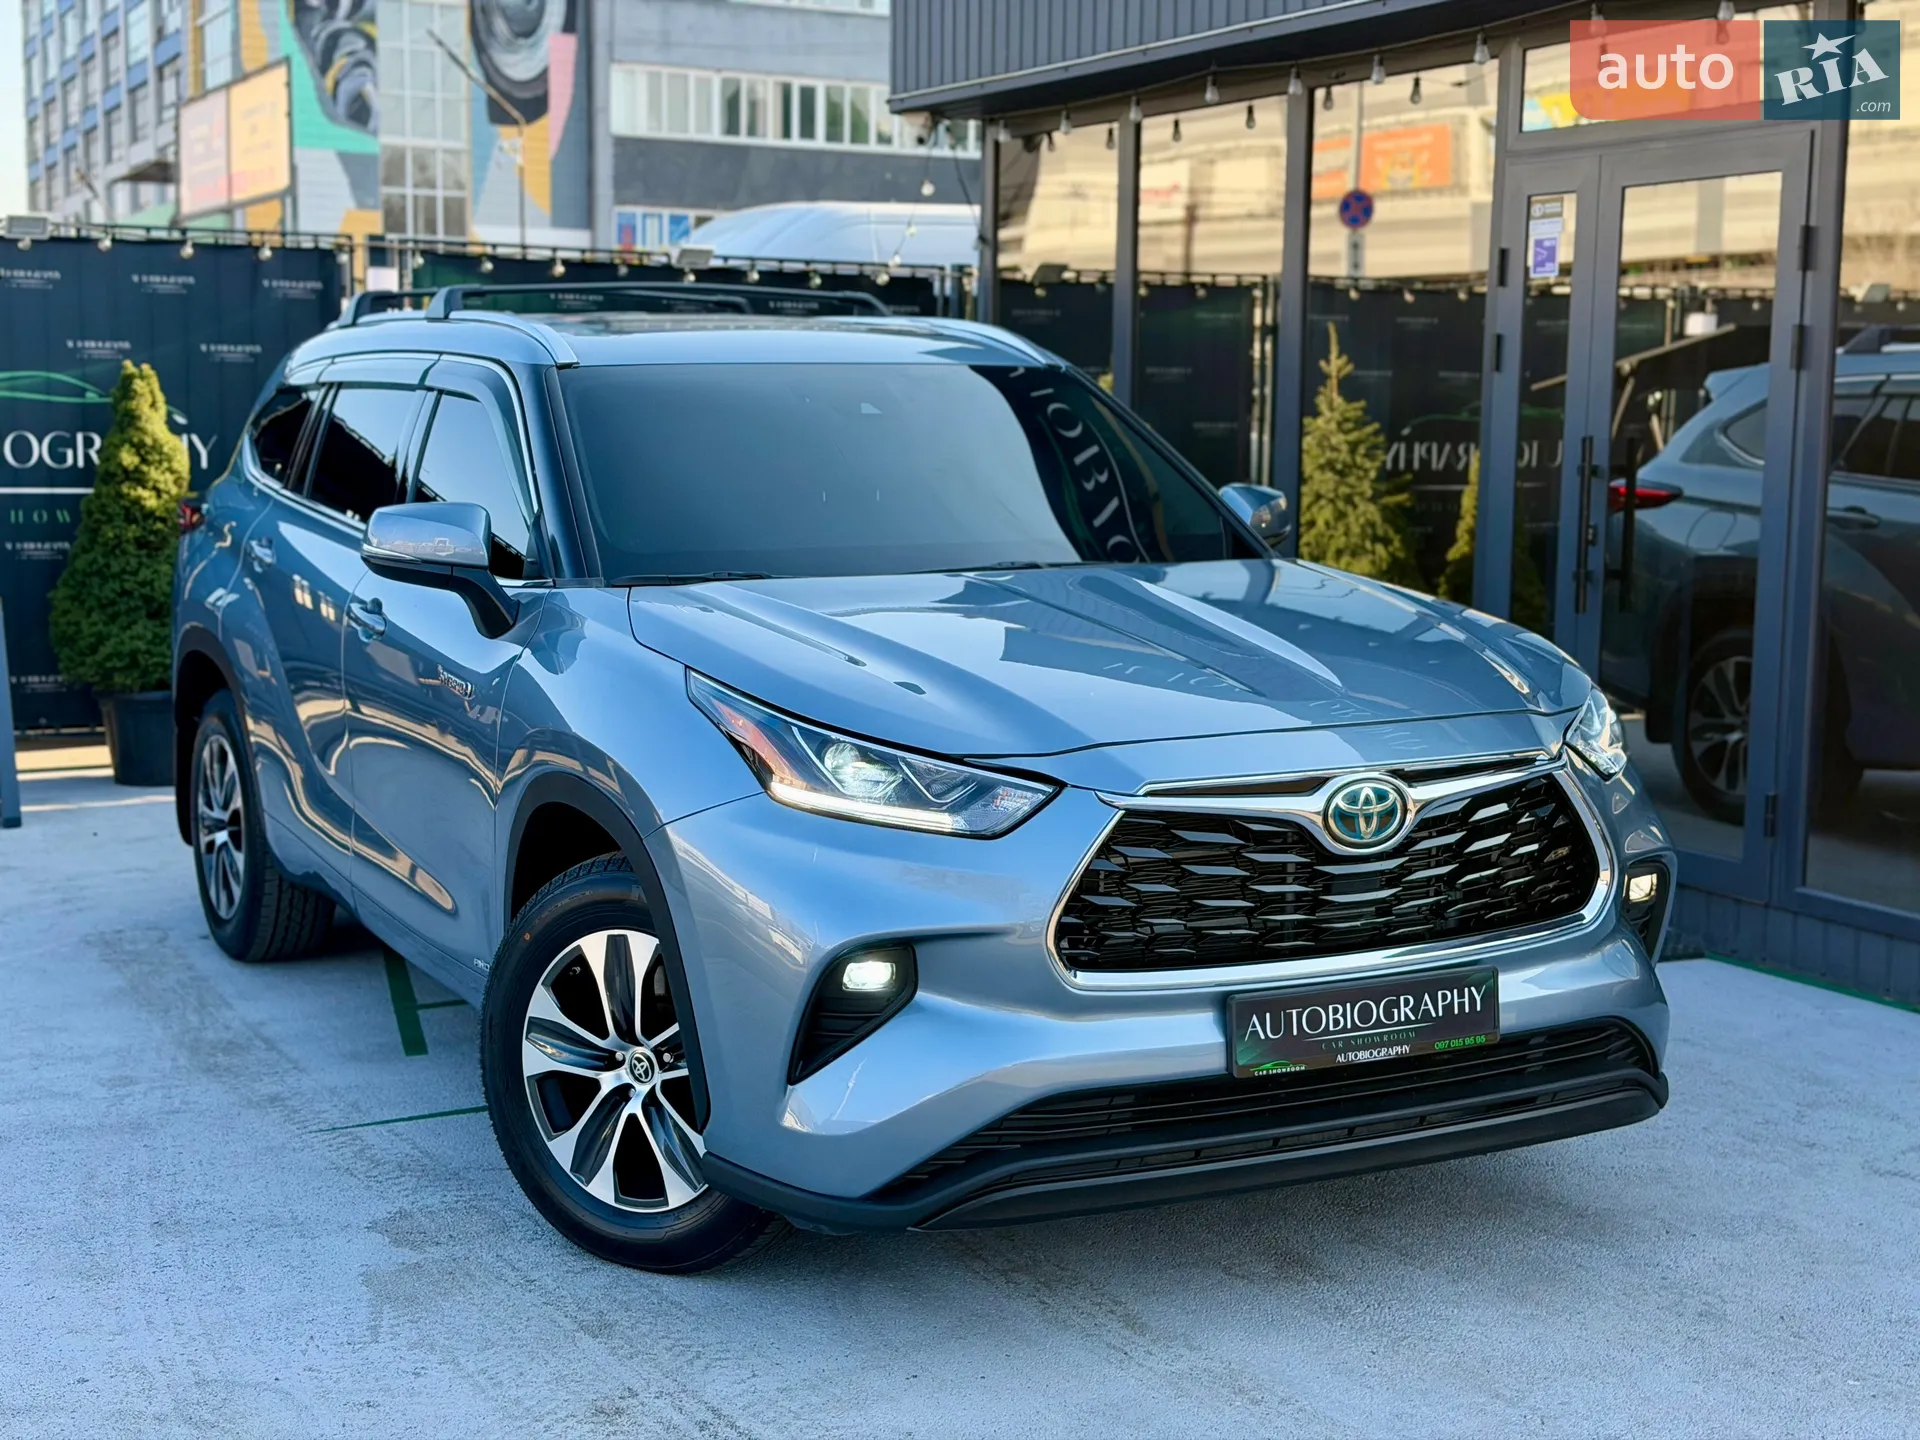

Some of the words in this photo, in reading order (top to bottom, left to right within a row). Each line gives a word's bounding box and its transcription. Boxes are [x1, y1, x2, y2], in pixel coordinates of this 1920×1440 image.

[1244, 984, 1486, 1042] AUTOBIOGRAPHY
[1335, 1044, 1411, 1063] AUTOBIOGRAPHY
[1269, 1065, 1306, 1075] SHOWROOM
